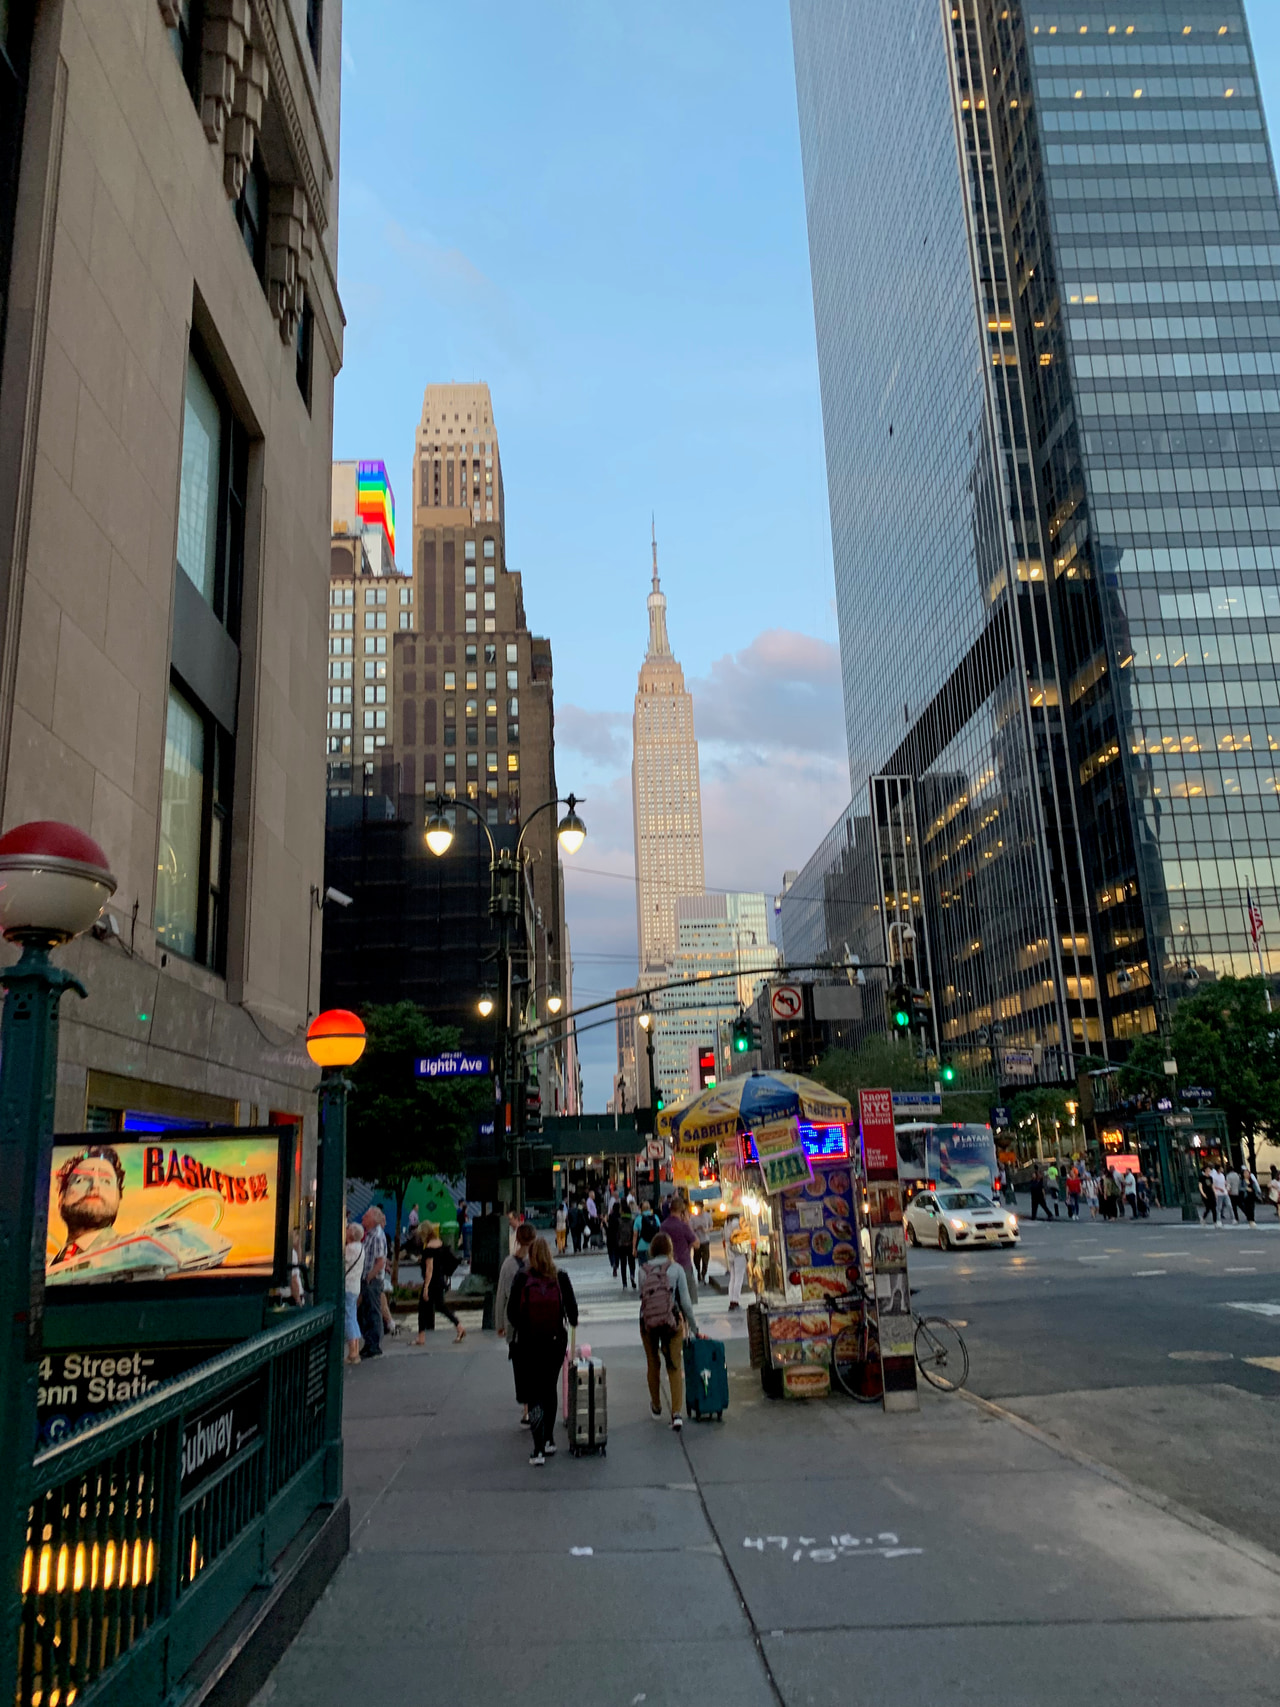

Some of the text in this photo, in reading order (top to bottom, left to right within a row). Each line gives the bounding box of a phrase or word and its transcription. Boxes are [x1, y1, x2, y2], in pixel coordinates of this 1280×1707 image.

[420, 1058, 483, 1076] Eighth Ave
[861, 1091, 889, 1101] know
[863, 1101, 890, 1112] NYC
[683, 1120, 735, 1142] SABRETT
[143, 1147, 249, 1206] BASKETS
[39, 1355, 53, 1381] 4
[37, 1375, 159, 1407] enn Stati
